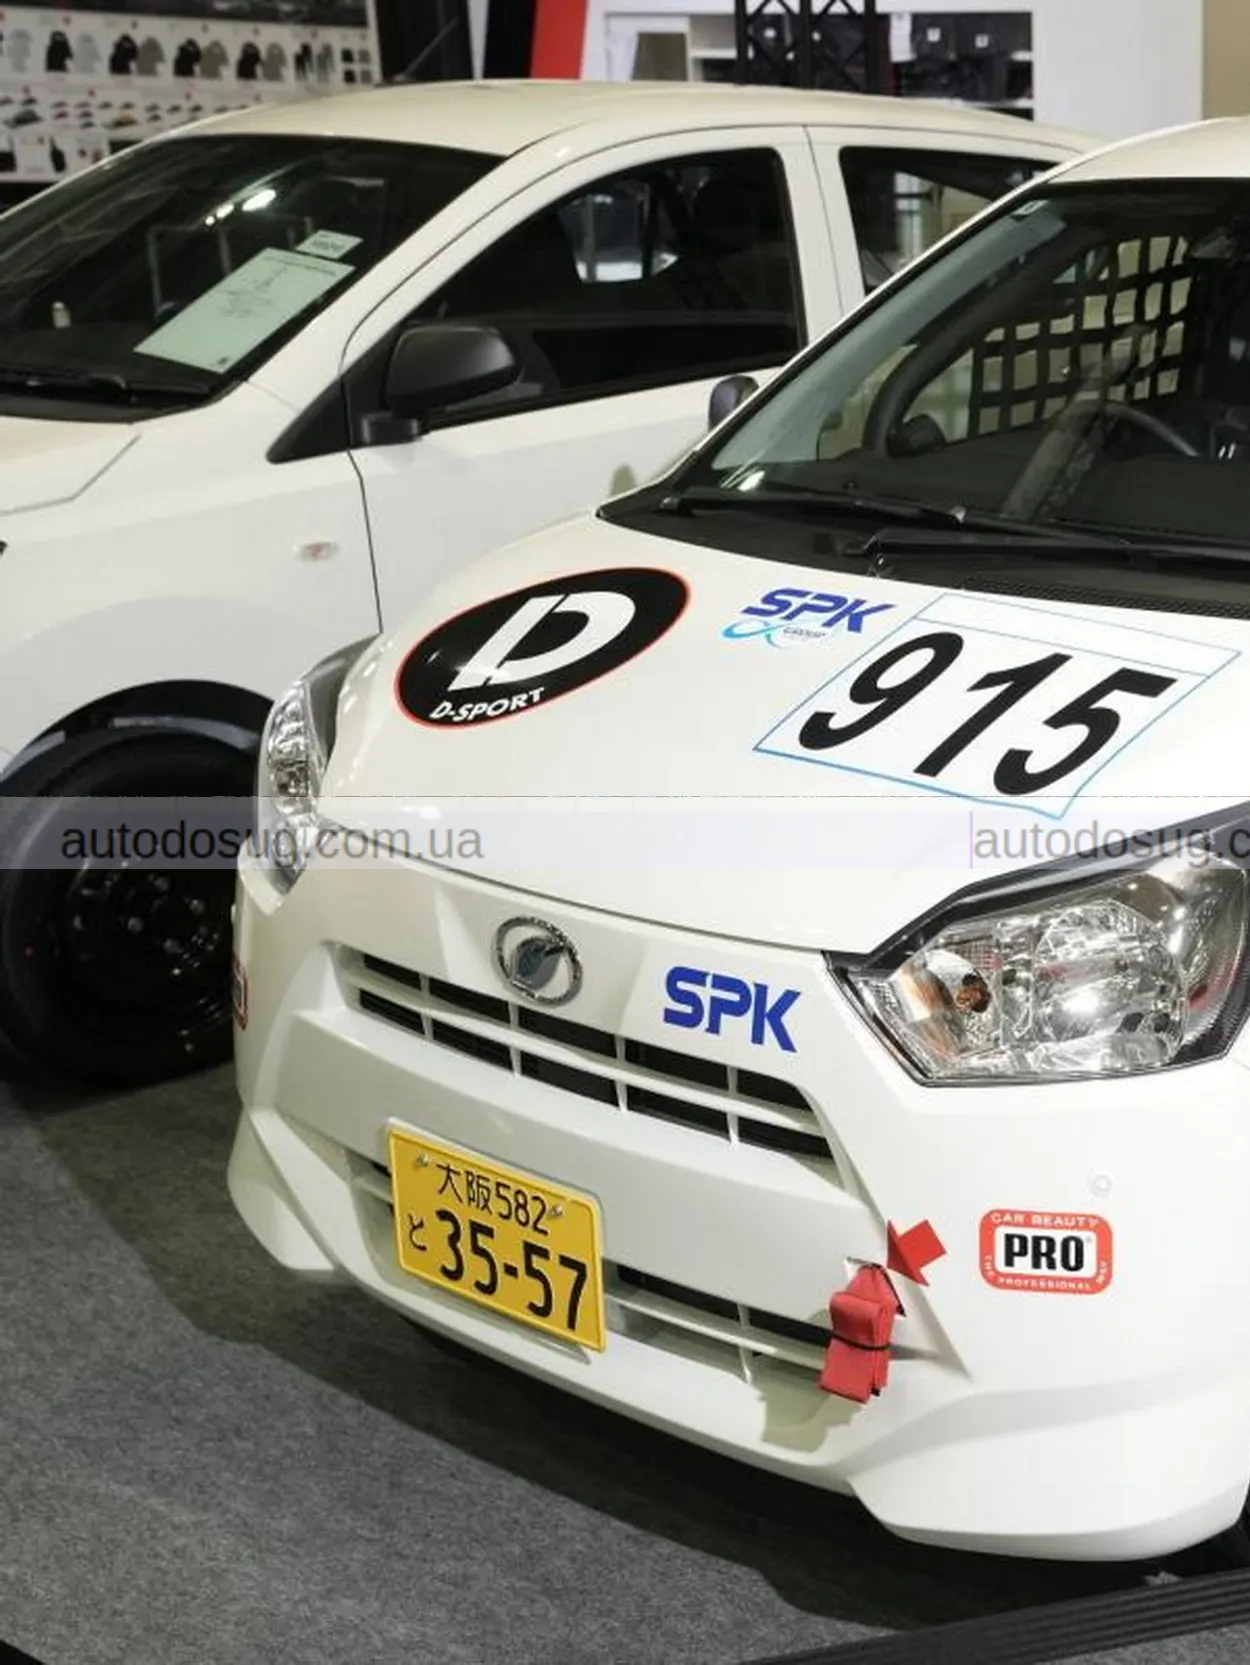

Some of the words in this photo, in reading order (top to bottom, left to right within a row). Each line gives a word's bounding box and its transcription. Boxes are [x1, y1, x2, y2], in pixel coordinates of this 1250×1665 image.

[741, 587, 897, 634] SPK
[429, 686, 545, 722] D-SPORT
[799, 631, 1178, 796] 915
[663, 965, 803, 1053] SPK
[990, 1211, 1025, 1225] CAR
[1031, 1213, 1100, 1229] BEAUTY
[407, 1212, 428, 1252] と
[435, 1208, 588, 1332] 35-57
[1003, 1232, 1085, 1273] PRO
[998, 1276, 1093, 1291] PROFESSIONAL
